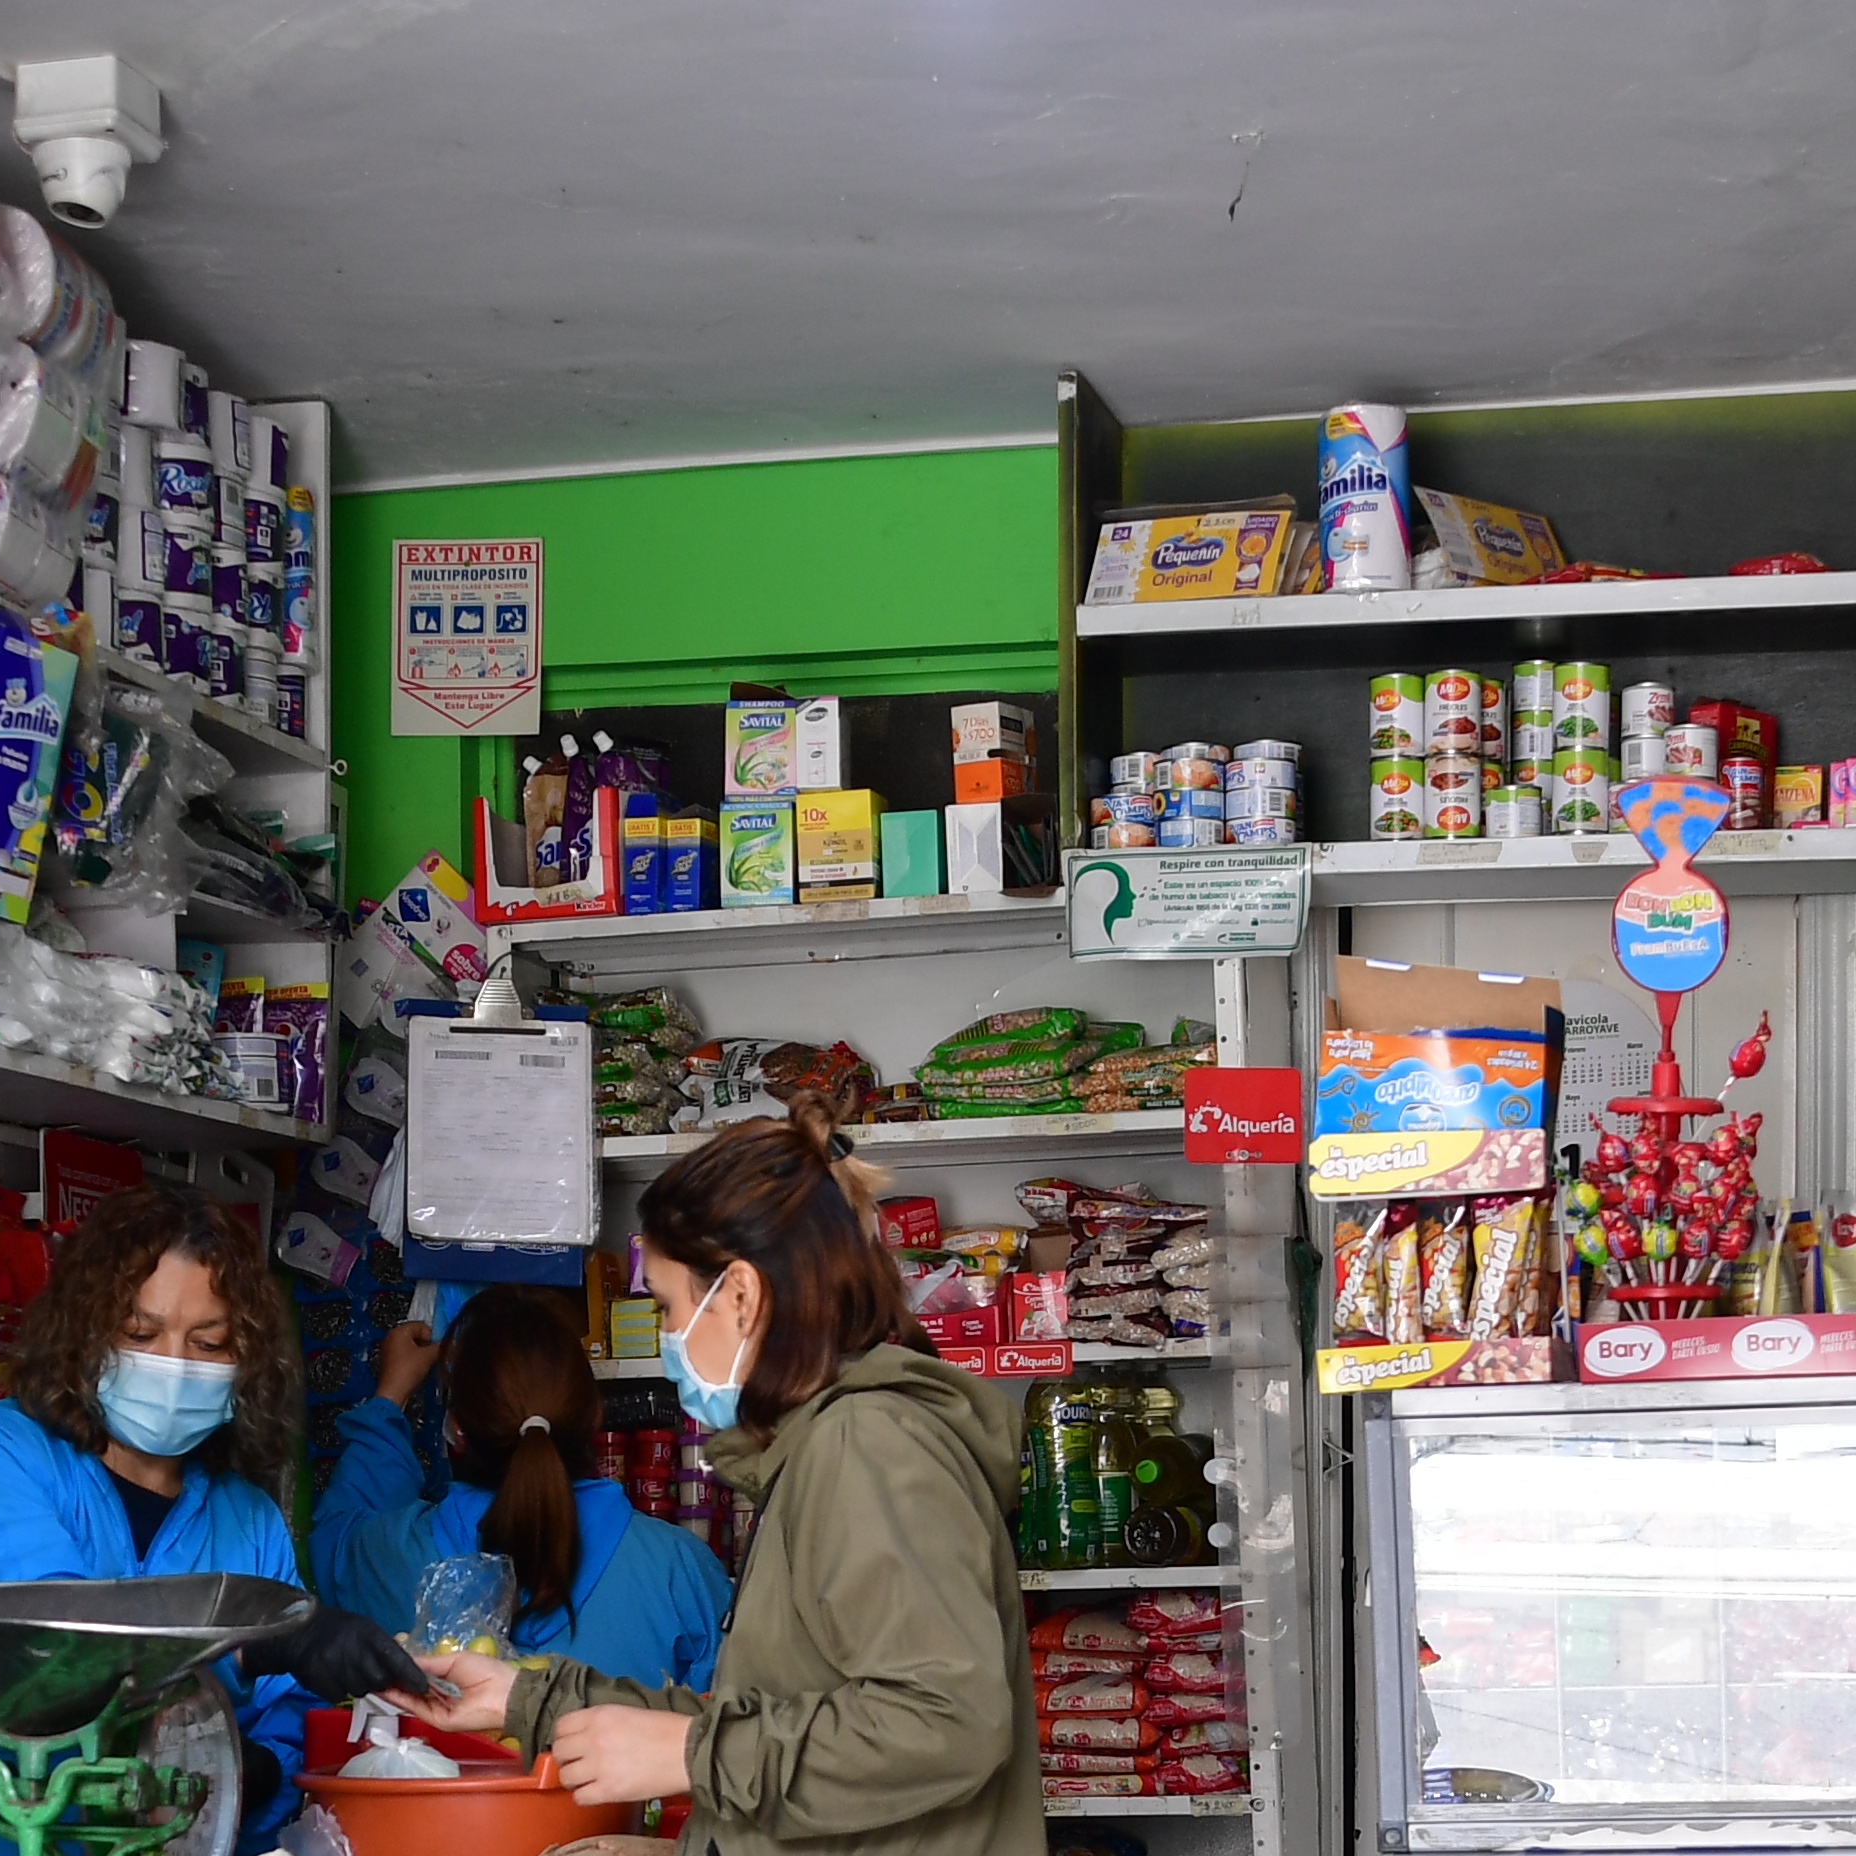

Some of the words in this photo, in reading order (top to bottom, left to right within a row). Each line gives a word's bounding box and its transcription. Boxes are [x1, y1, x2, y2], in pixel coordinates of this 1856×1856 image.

[1114, 529, 1130, 539] 24
[406, 545, 533, 563] EXTINTOR
[411, 568, 527, 582] MULTIPROPOSITO
[1152, 570, 1213, 588] Original
[434, 692, 480, 702] Mantenga
[481, 691, 505, 700] Libre
[444, 701, 465, 710] Este
[467, 700, 494, 711] Lugar
[740, 714, 784, 728] SAVITAL
[731, 816, 775, 830] SAVITAL
[801, 808, 828, 823] 10x
[1159, 859, 1201, 872] Respire
[1204, 859, 1225, 868] con
[1227, 854, 1298, 869] tranquilidad
[575, 901, 606, 910] Kinder
[1647, 913, 1693, 930] BUM
[450, 949, 481, 980] sobre
[1565, 1022, 1620, 1035] ARROYAVE
[1219, 1112, 1295, 1137] Alquería
[1320, 1141, 1428, 1181] especial
[1599, 1339, 1654, 1361] Bary
[1746, 1333, 1802, 1356] Bary
[1017, 1354, 1062, 1369] Alquería
[1336, 1348, 1432, 1385] especial
